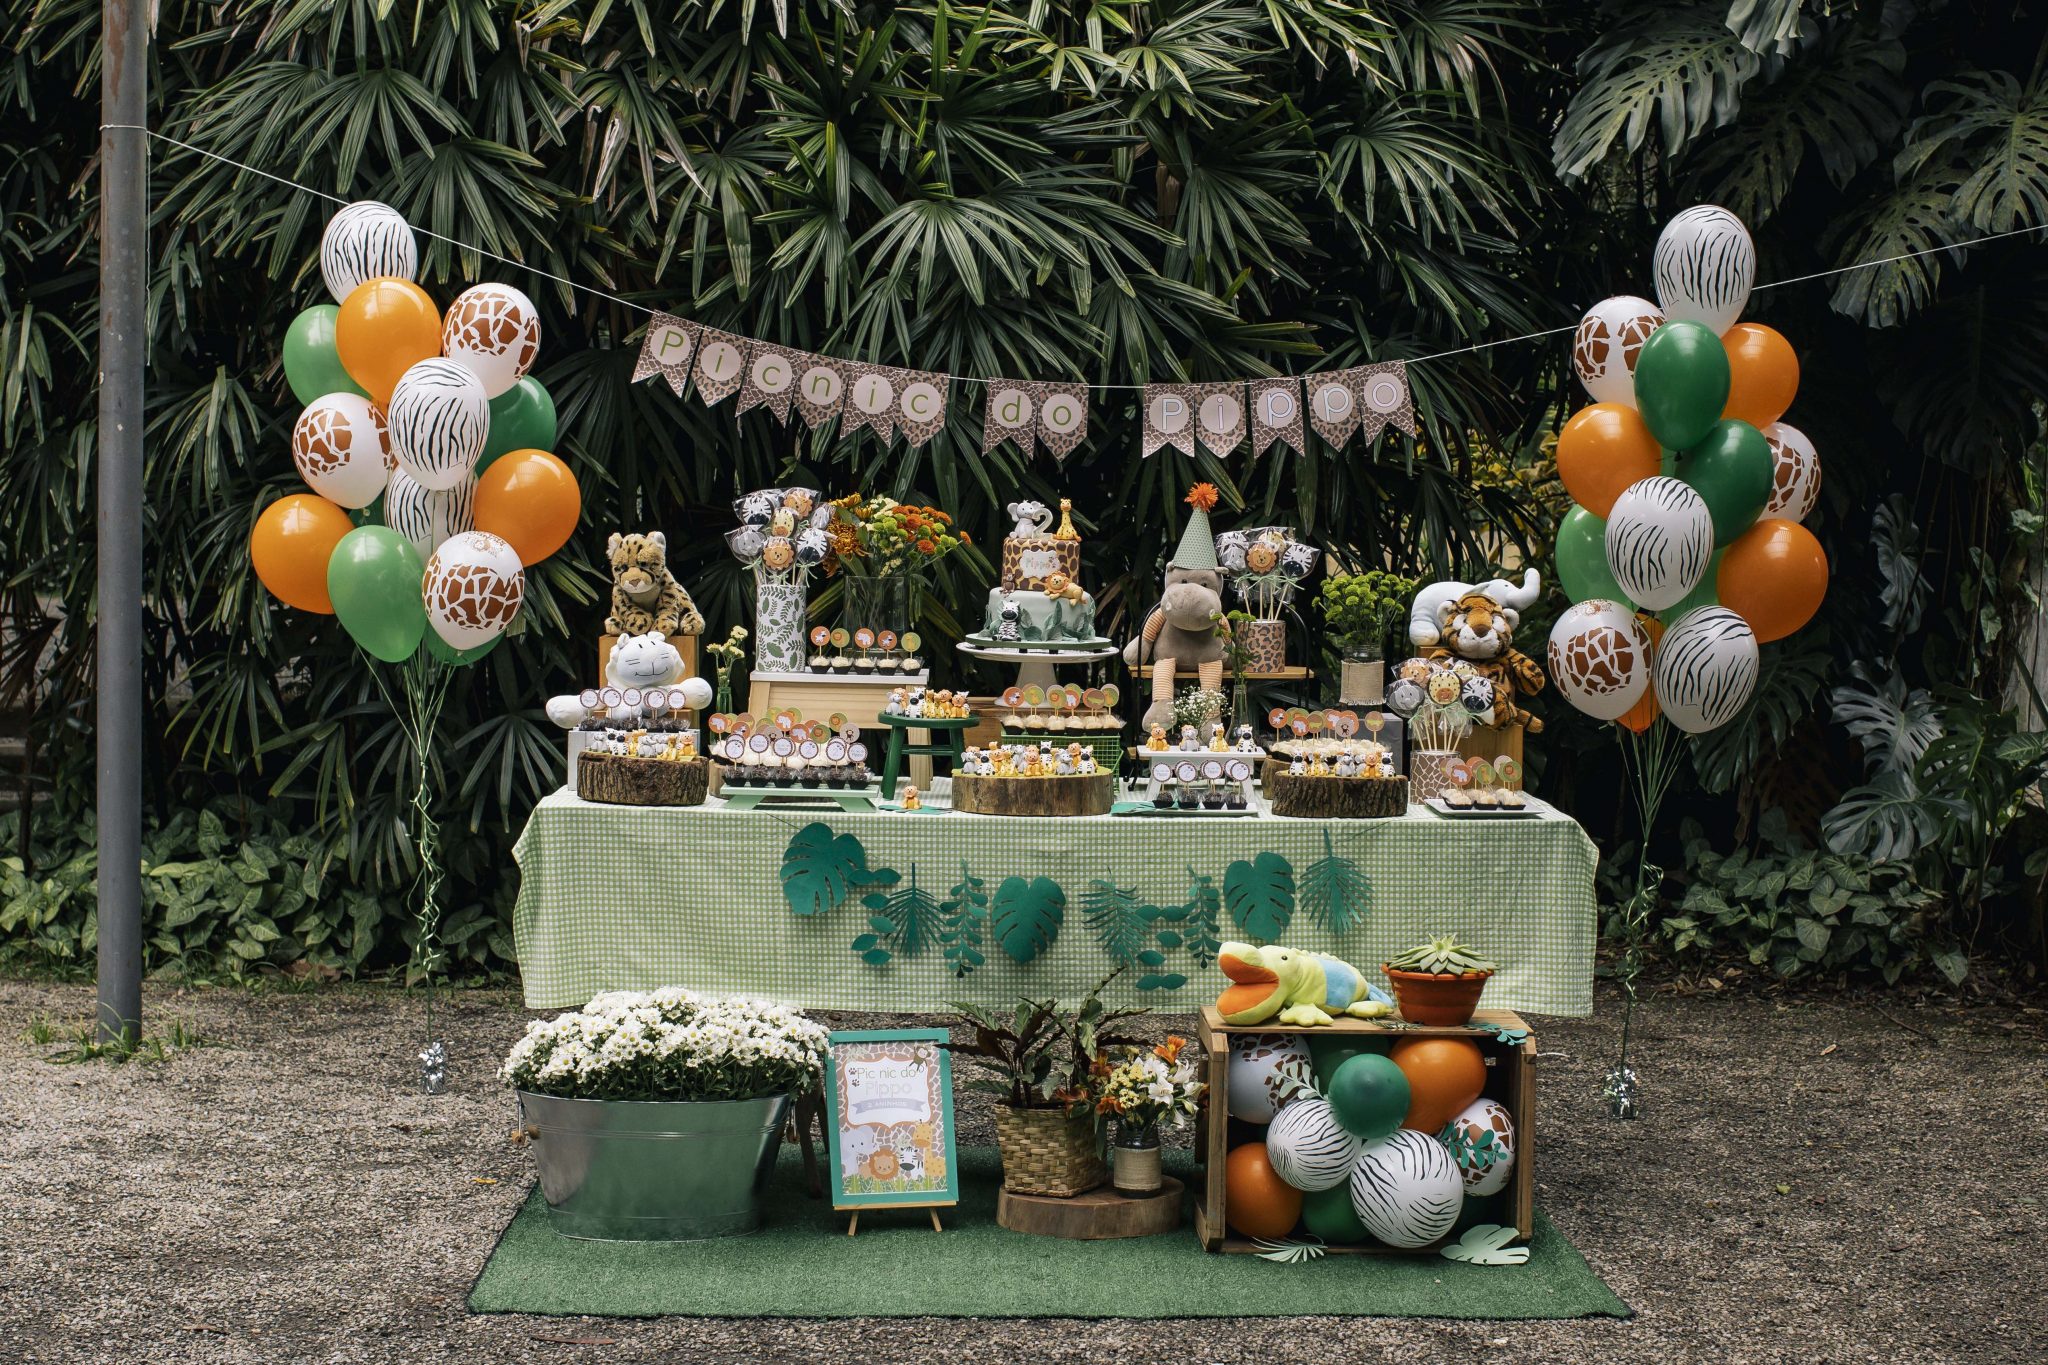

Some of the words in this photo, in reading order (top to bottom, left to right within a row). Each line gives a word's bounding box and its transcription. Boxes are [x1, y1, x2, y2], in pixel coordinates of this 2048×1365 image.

[659, 329, 929, 415] Picnic
[1002, 395, 1071, 426] do
[1161, 381, 1398, 430] Pippo
[1032, 507, 1053, 539] 2
[857, 1067, 875, 1079] Pic
[879, 1066, 897, 1079] nic
[900, 1065, 917, 1078] do
